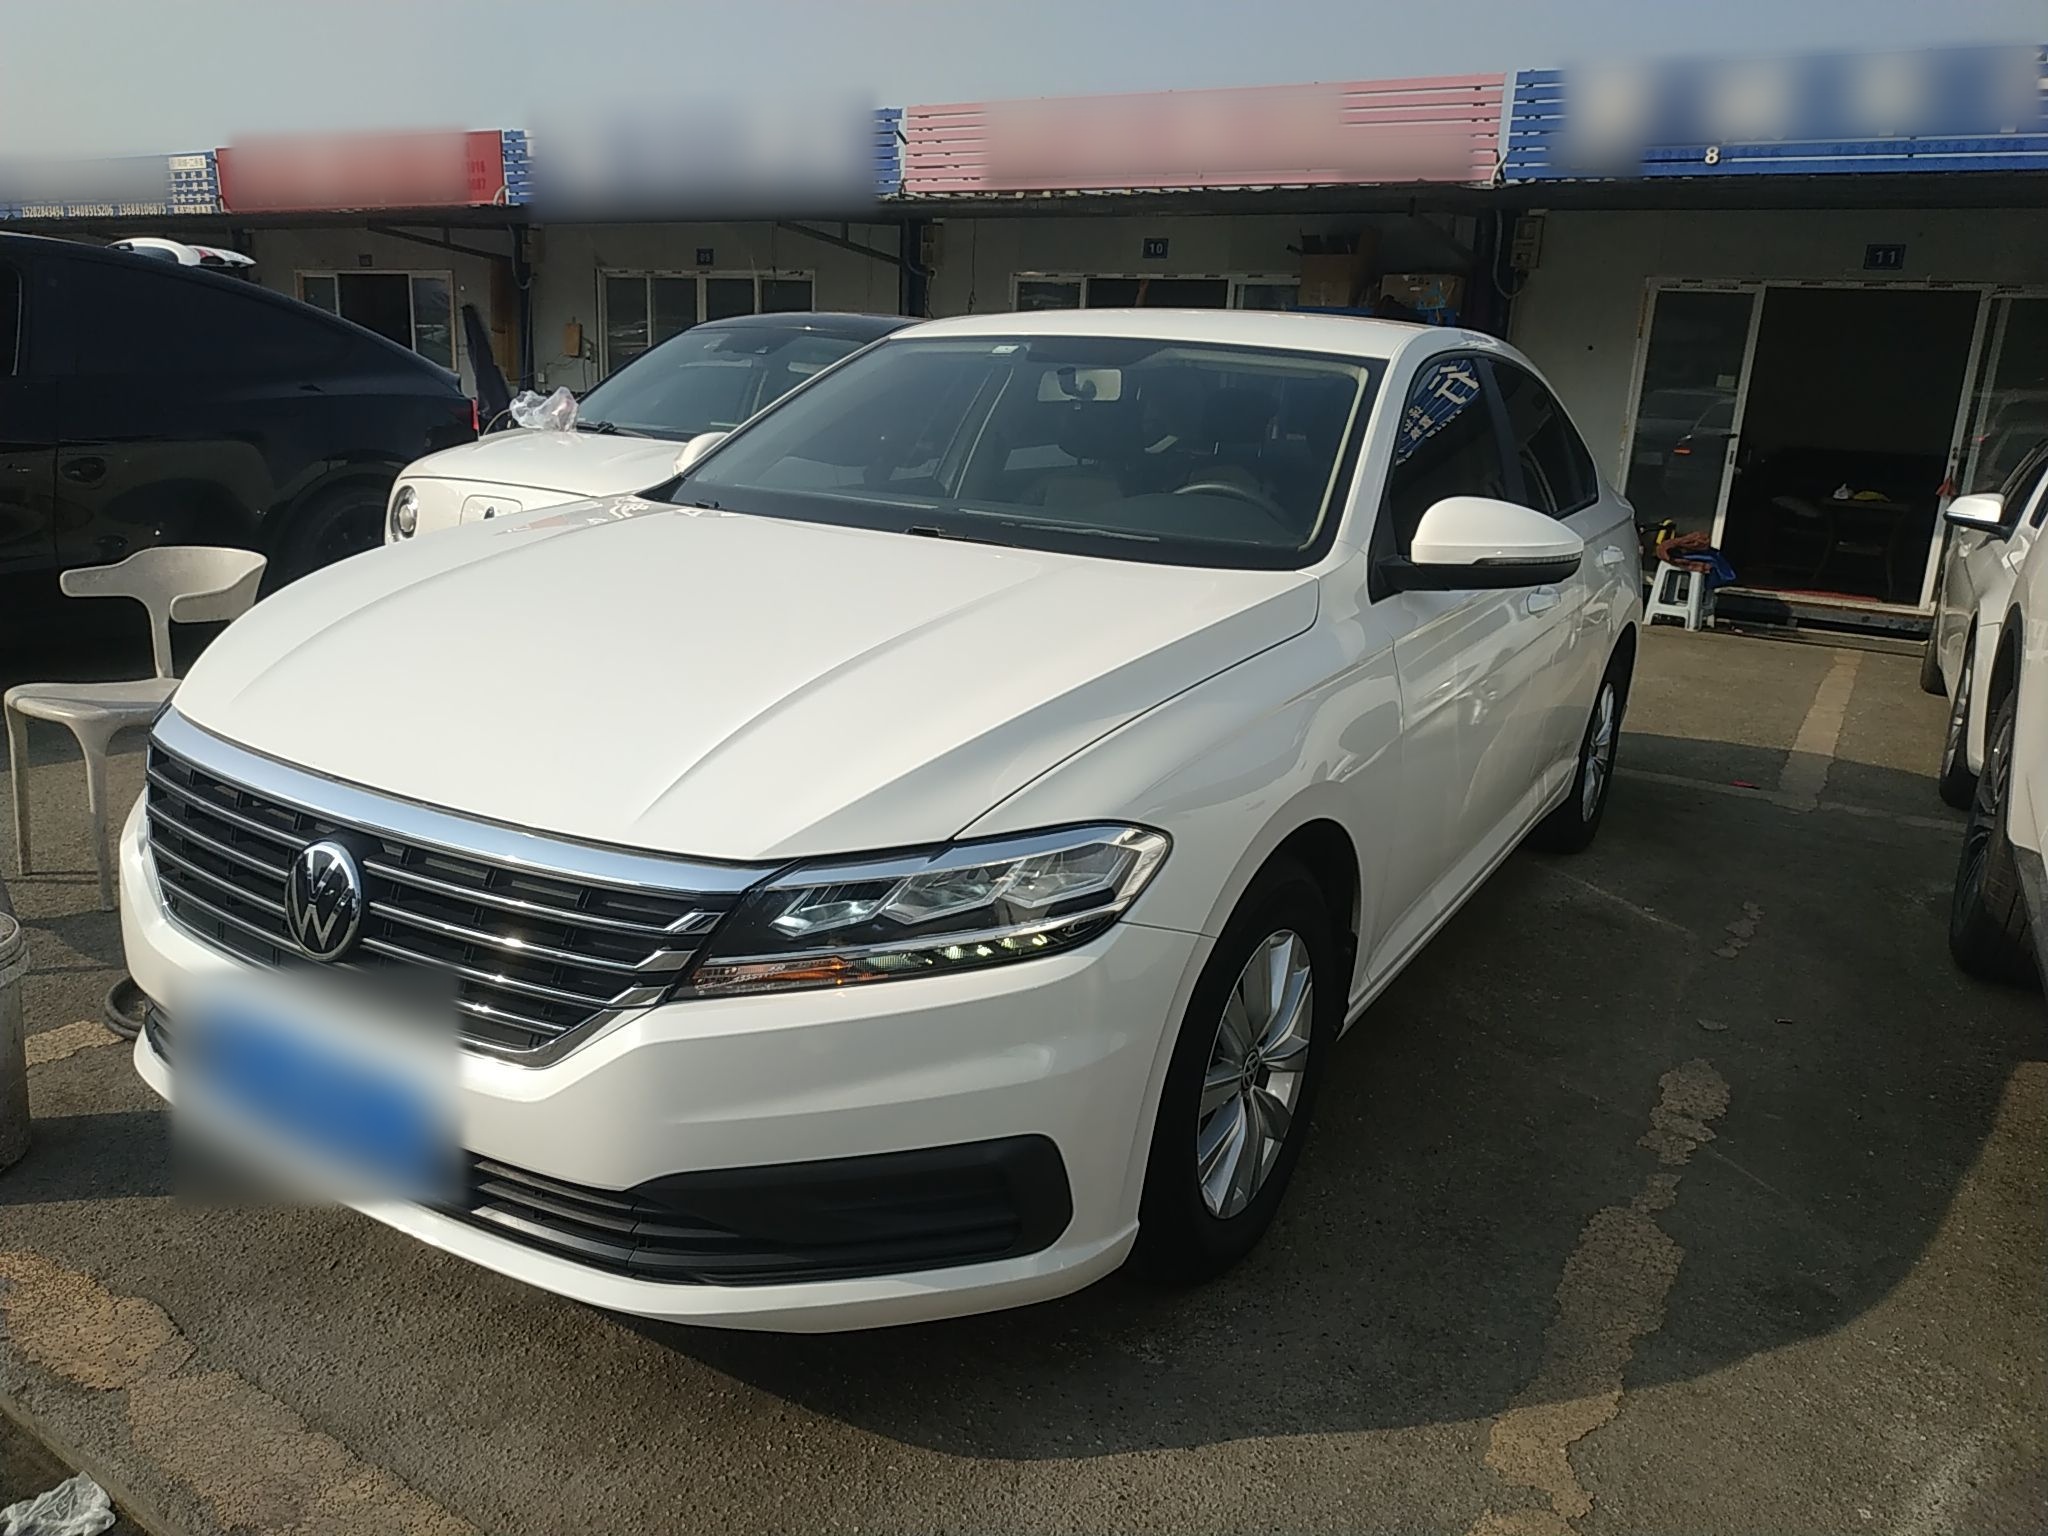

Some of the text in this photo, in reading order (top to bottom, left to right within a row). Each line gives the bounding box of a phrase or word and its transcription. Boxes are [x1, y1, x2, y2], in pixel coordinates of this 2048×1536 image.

[1705, 146, 1719, 164] 8
[1149, 243, 1163, 254] 10
[1876, 251, 1896, 264] 11
